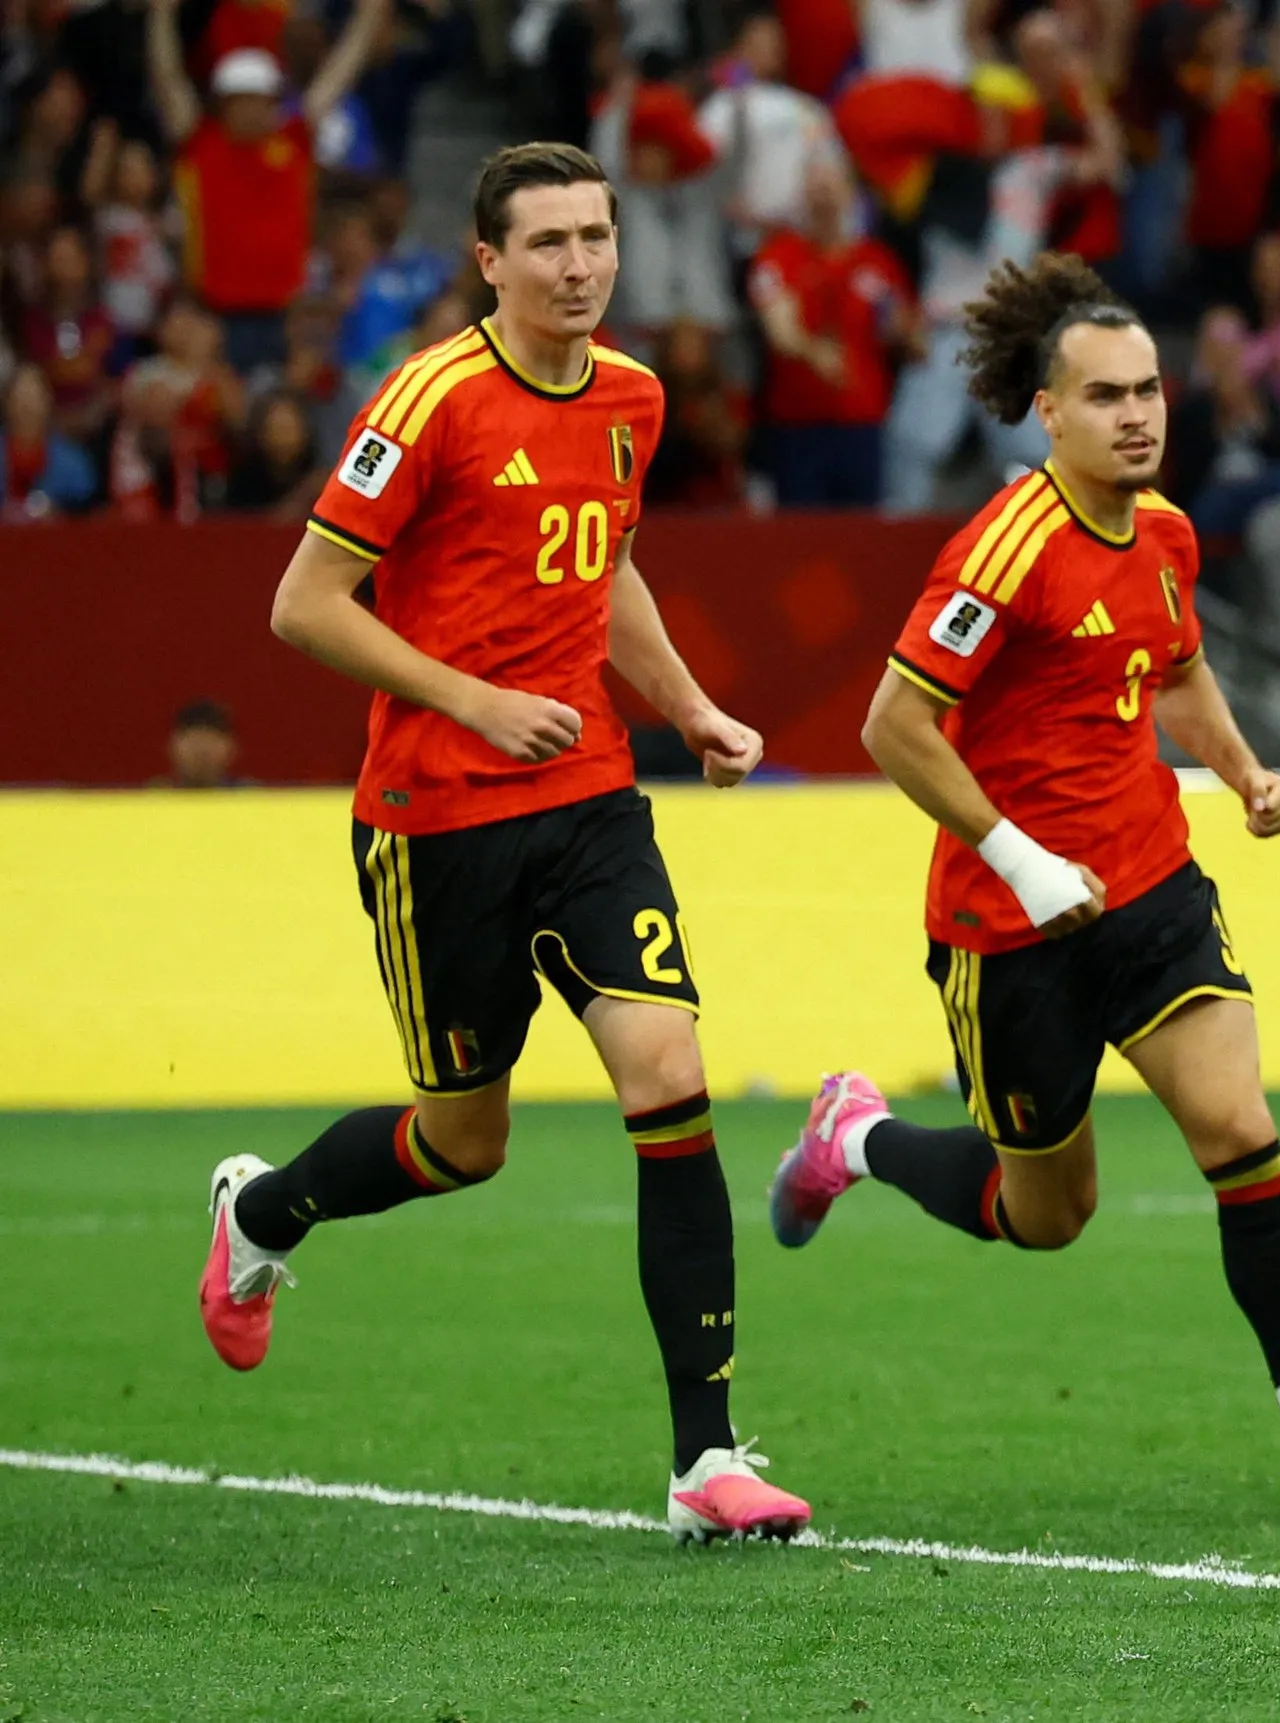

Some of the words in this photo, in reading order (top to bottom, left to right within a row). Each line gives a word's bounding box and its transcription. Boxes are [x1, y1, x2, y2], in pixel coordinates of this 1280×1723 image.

[536, 501, 608, 584] 20
[1116, 648, 1152, 722] 3
[633, 907, 694, 984] 2
